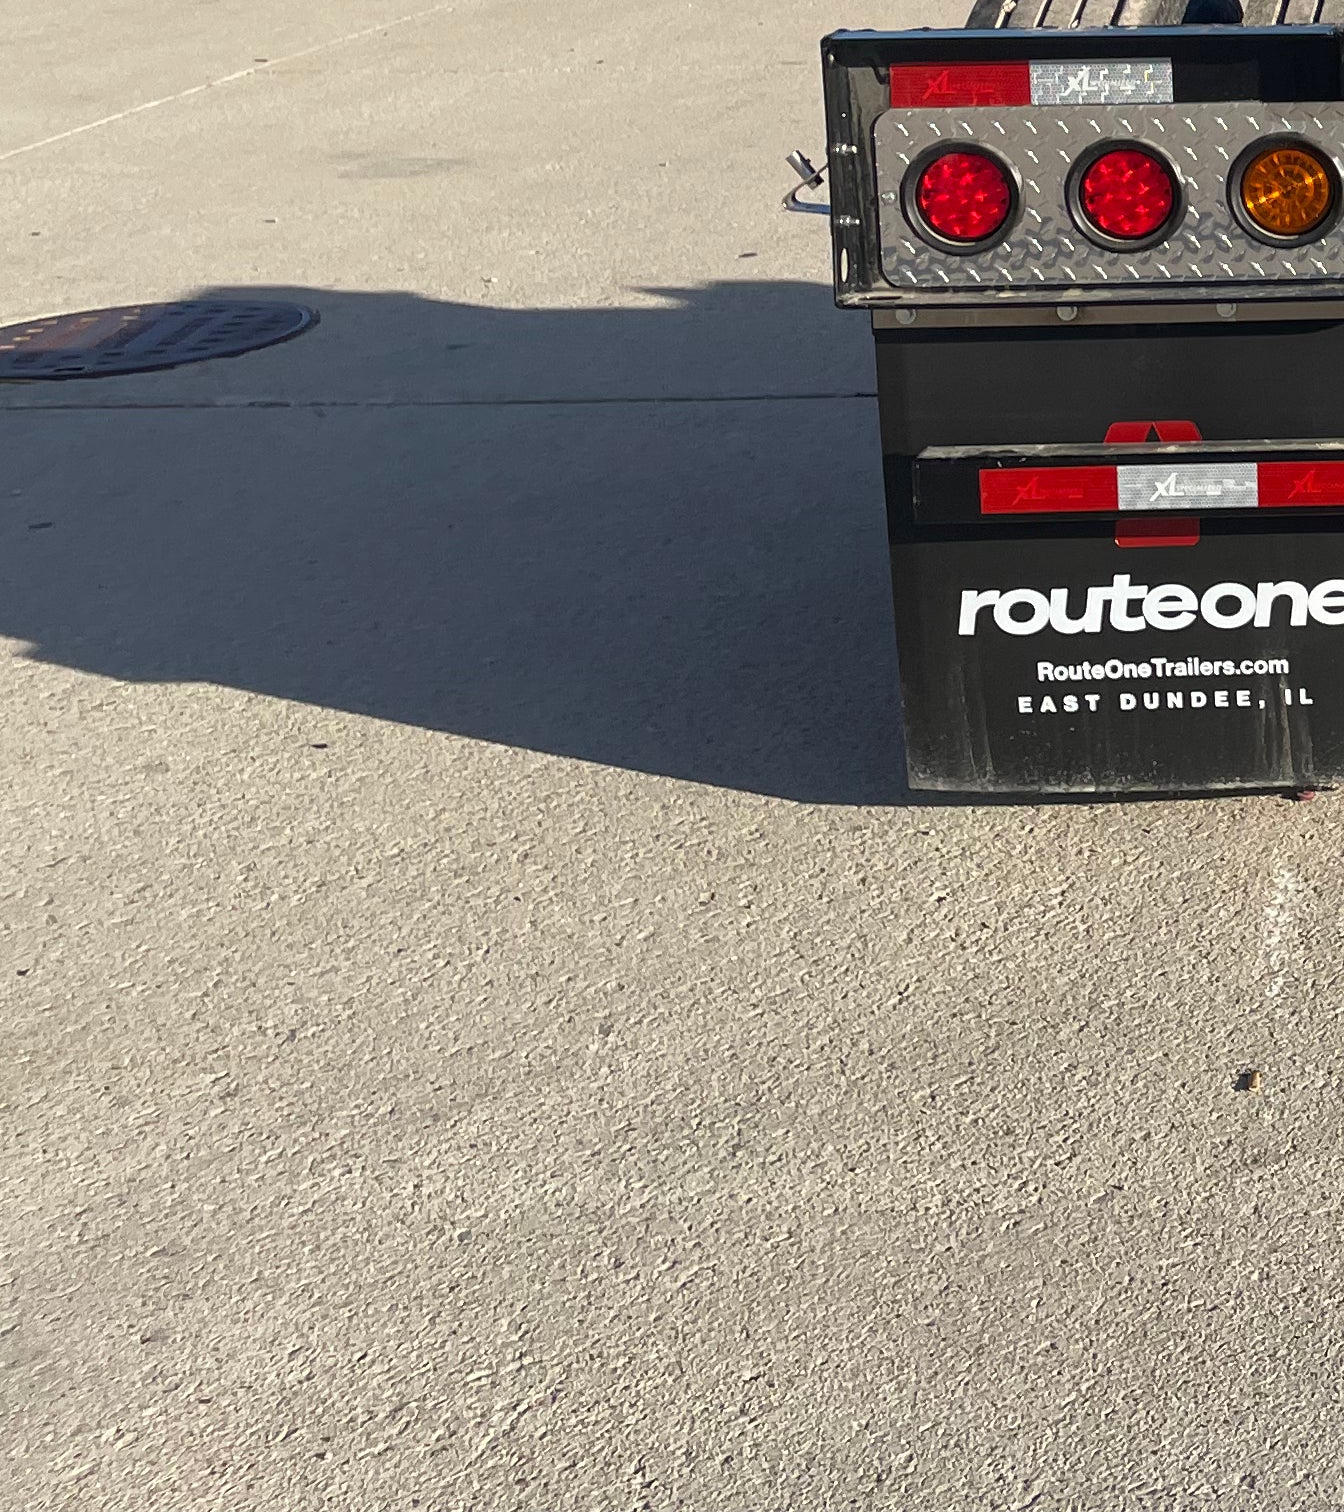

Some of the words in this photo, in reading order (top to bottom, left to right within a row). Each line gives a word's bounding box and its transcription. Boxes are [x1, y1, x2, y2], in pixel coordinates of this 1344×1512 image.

[1149, 472, 1184, 501] XL
[1037, 656, 1290, 682] RouteOneTrailers.com
[1017, 694, 1101, 714] EAST
[1119, 689, 1266, 711] DUNDEE,
[1284, 687, 1314, 706] IL
